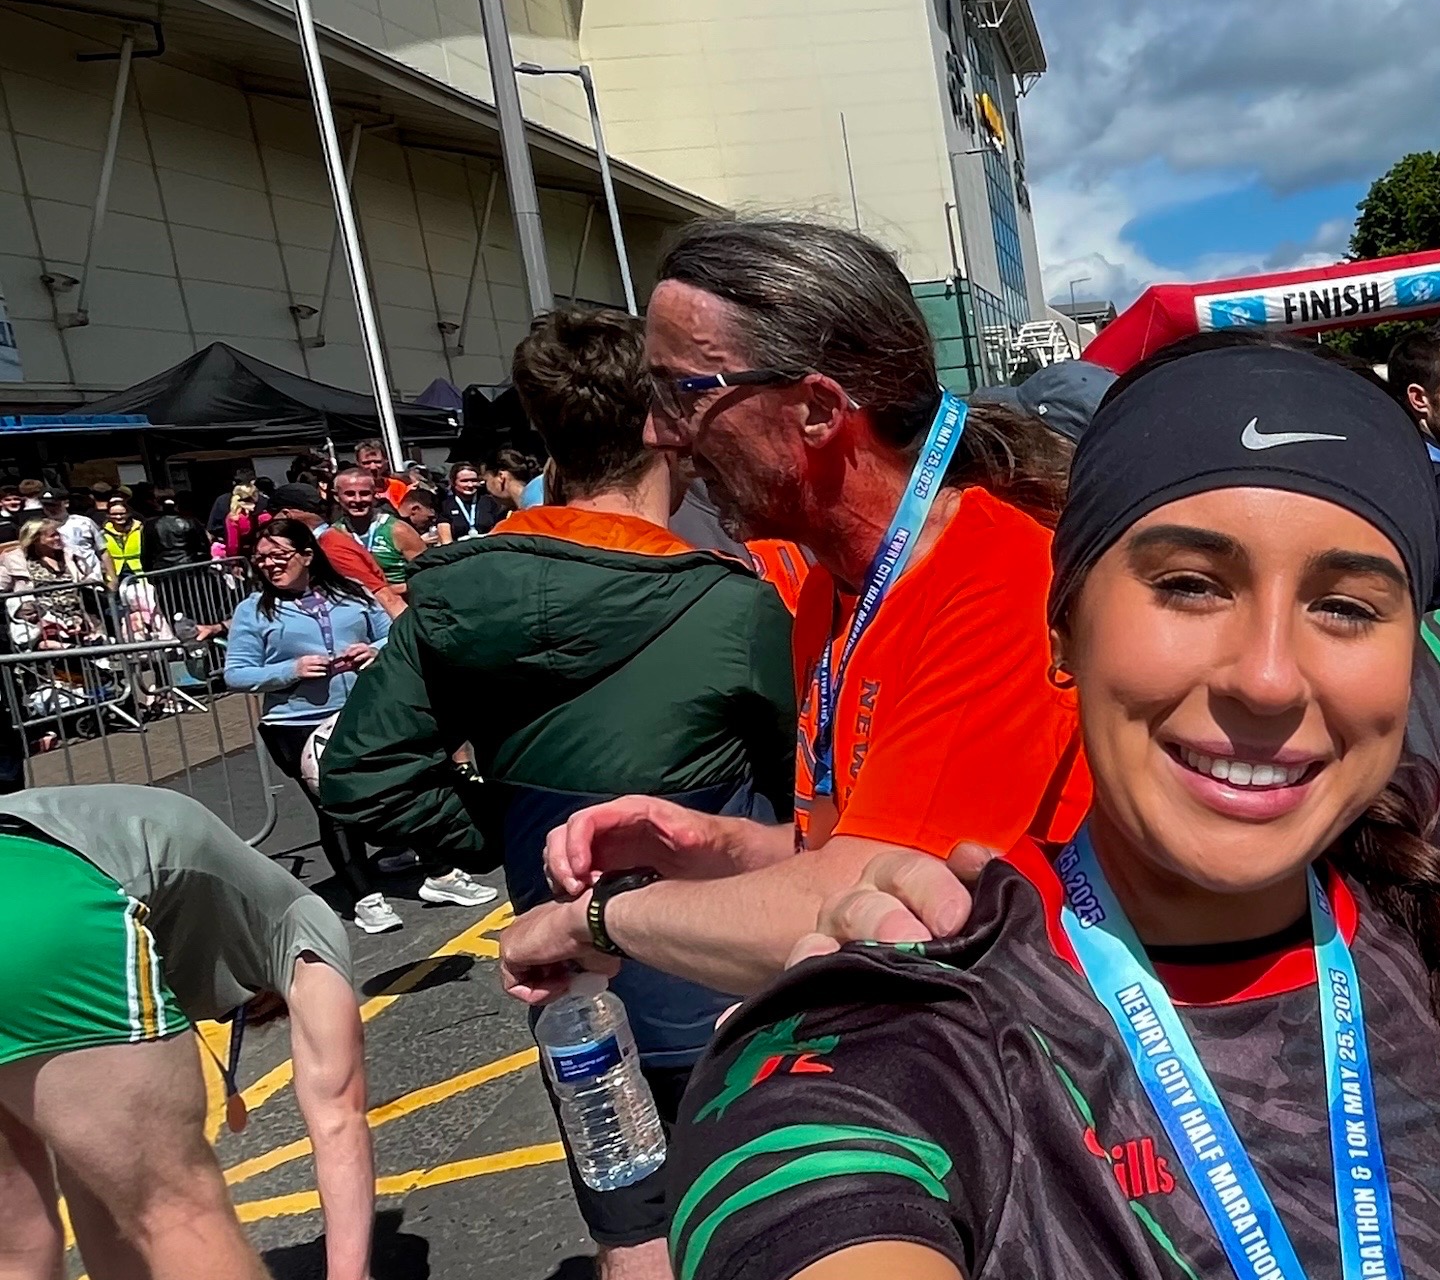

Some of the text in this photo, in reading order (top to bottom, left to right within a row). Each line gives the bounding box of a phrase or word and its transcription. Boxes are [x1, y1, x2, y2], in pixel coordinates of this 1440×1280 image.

[1283, 281, 1381, 324] FINISH
[934, 425, 953, 451] MAY
[915, 466, 934, 499] 2025
[883, 527, 910, 566] NEWRY
[872, 562, 892, 589] CITY
[861, 584, 880, 612] HALF
[1065, 873, 1105, 928] 2025
[1329, 968, 1355, 1024] 2025
[1115, 981, 1172, 1057] NEWRY
[1155, 1057, 1197, 1109] CITY
[1180, 1107, 1224, 1163] HALF
[1340, 1068, 1366, 1116] MAY
[1346, 1120, 1370, 1160] 10K
